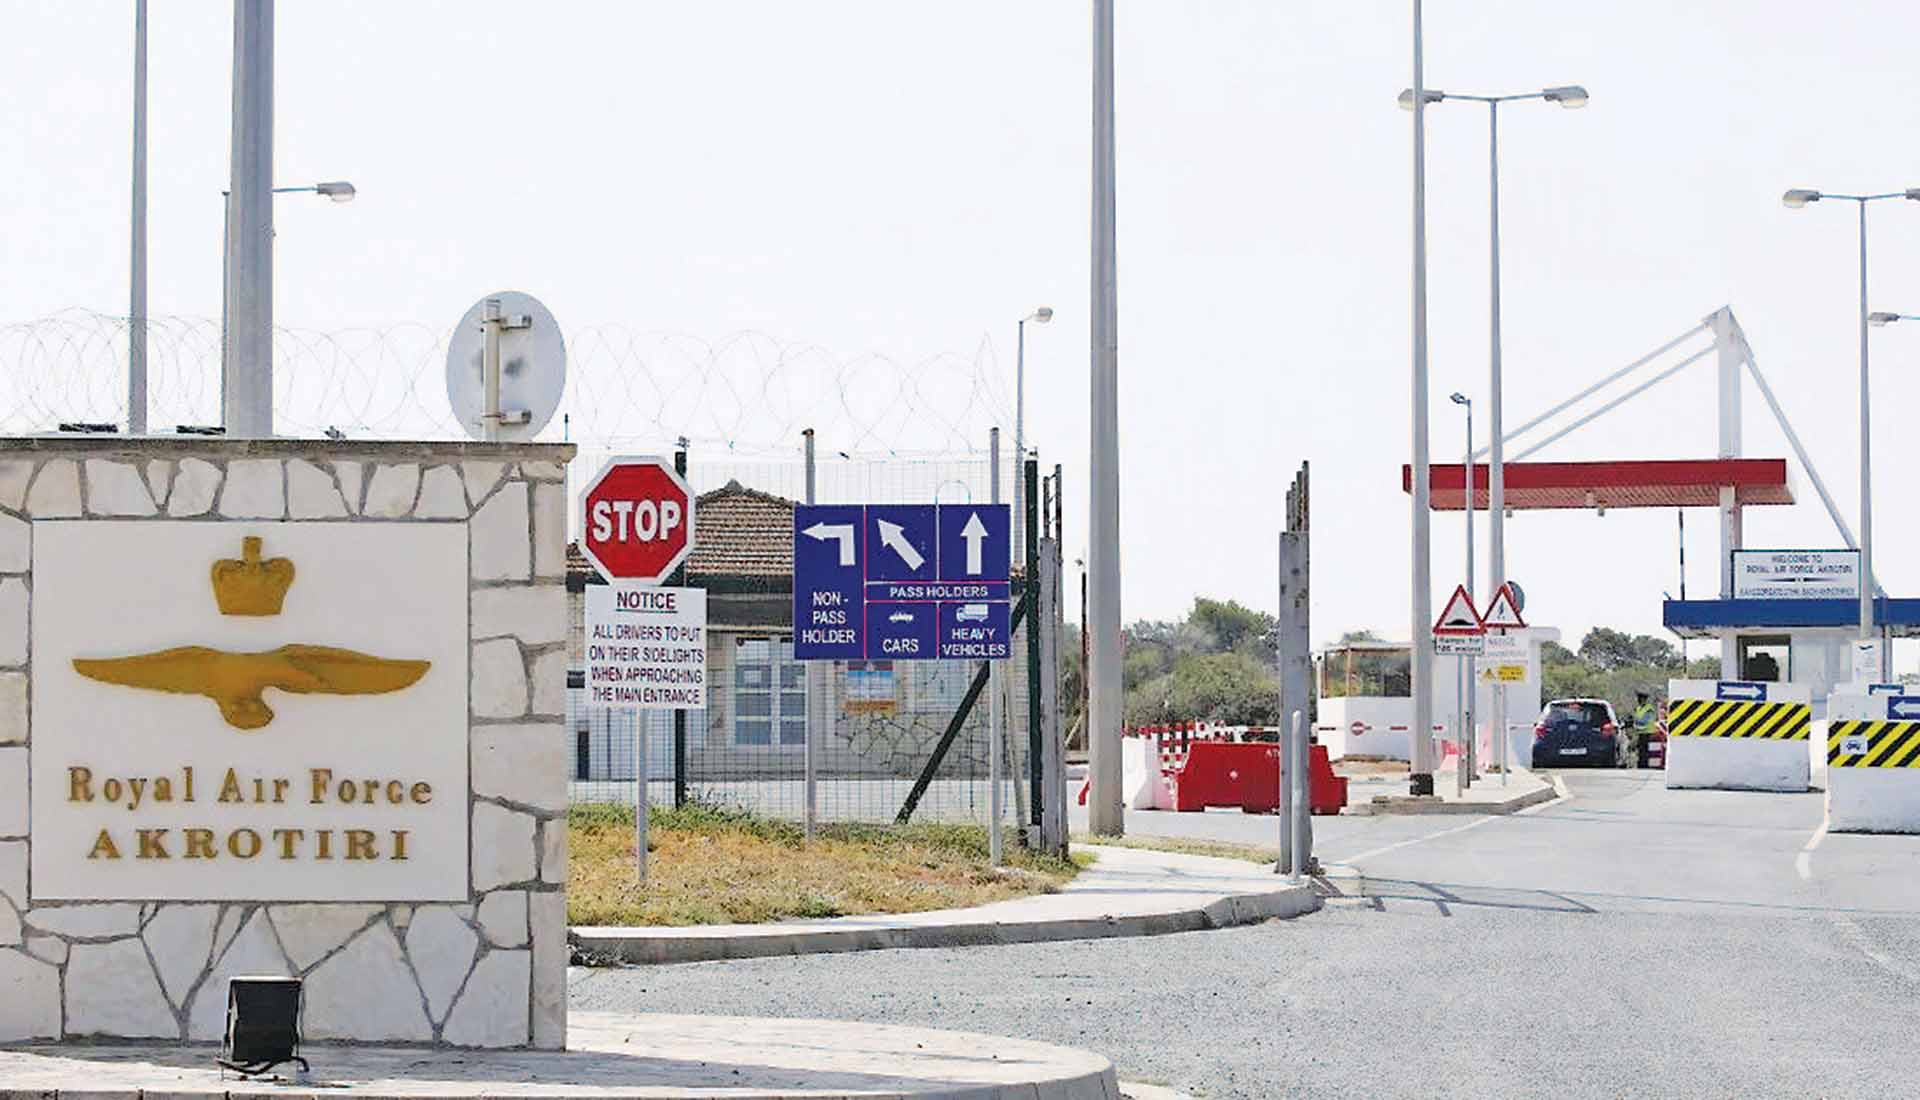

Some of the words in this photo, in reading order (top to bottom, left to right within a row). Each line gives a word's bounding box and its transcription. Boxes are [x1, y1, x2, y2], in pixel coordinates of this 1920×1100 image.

[592, 499, 681, 542] STOP
[1771, 554, 1810, 564] WELCOME
[1812, 554, 1823, 564] TO
[617, 591, 676, 610] NOTICE
[889, 586, 924, 598] PASS
[926, 586, 989, 598] HOLDERS
[812, 611, 847, 625] PASS
[593, 623, 613, 640] ALL
[615, 624, 662, 641] DRIVERS
[664, 626, 679, 642] TO
[681, 626, 701, 642] PUT
[802, 629, 856, 644] HOLDER
[951, 627, 996, 640] HEAVY
[589, 644, 605, 661] ON
[608, 646, 640, 662] THEIR
[642, 647, 705, 664] SIDELIGHTS
[882, 638, 919, 653] CARS
[942, 643, 1006, 656] VEHICLES
[591, 666, 623, 683] WHEN
[626, 667, 703, 684] APPROACHING
[592, 686, 613, 702] THE
[615, 687, 641, 703] MAIN
[643, 688, 701, 705] ENTRANCE
[67, 765, 196, 811] Royal
[216, 766, 291, 804] Air
[308, 767, 434, 805] Force
[86, 828, 412, 861] AKROTIRI
